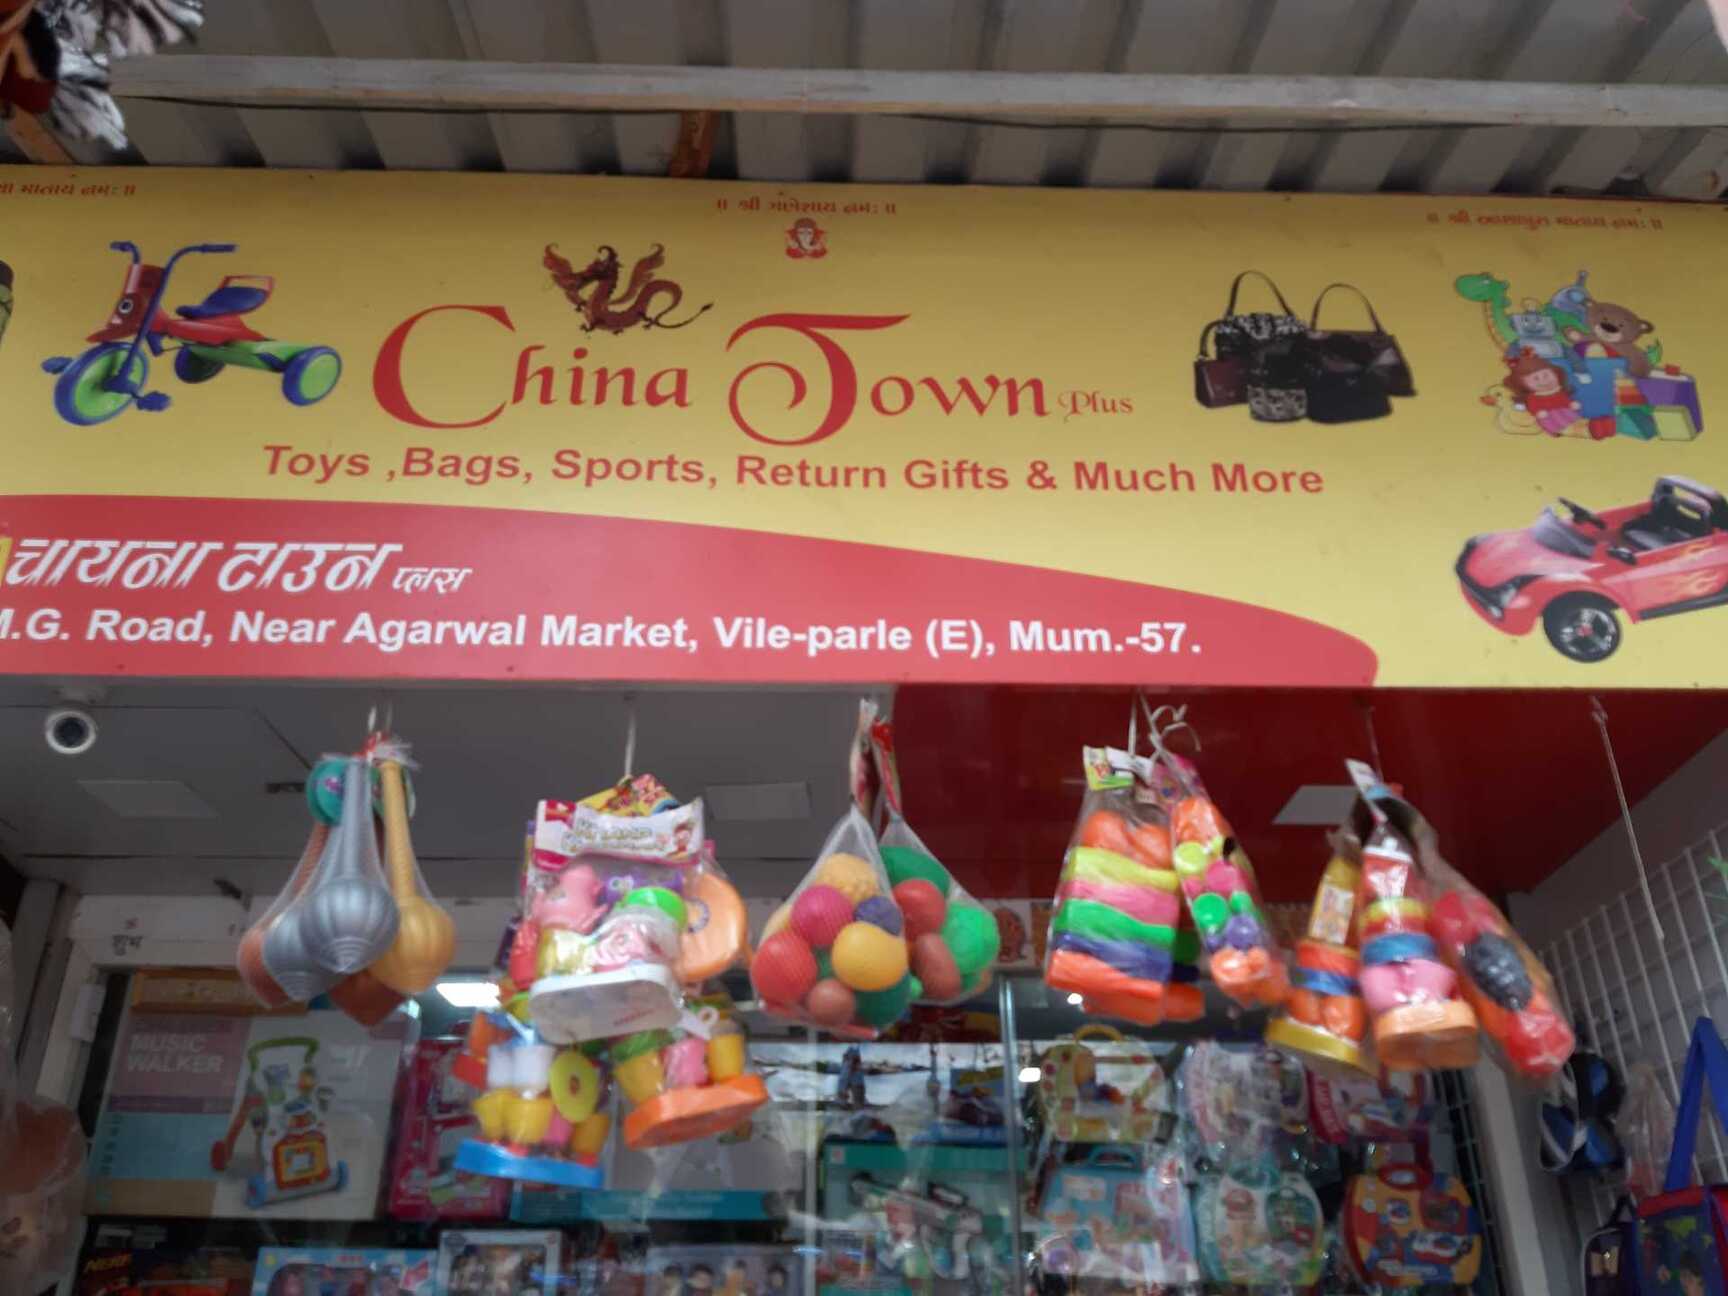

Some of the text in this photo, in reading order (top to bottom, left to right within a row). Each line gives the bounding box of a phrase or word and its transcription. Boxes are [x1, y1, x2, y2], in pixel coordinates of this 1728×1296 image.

[373, 304, 1134, 447] China Town Plus
[263, 445, 371, 484] Toys
[551, 448, 718, 488] Sports,
[735, 454, 887, 487] Return
[903, 459, 1009, 490] Gifts
[1026, 460, 1057, 490] &
[1073, 460, 1196, 493] Much
[1211, 463, 1324, 494] More
[6, 538, 472, 595] चायना टाउन प्लस
[86, 609, 214, 647] Road,
[229, 612, 337, 645] Near
[343, 612, 527, 654] Agarwal
[540, 614, 699, 654] Market,
[713, 616, 913, 657] Vile-parle
[926, 617, 996, 659] (E),
[1009, 620, 1204, 654] Mum.-57.
[127, 1054, 225, 1073] WALKER
